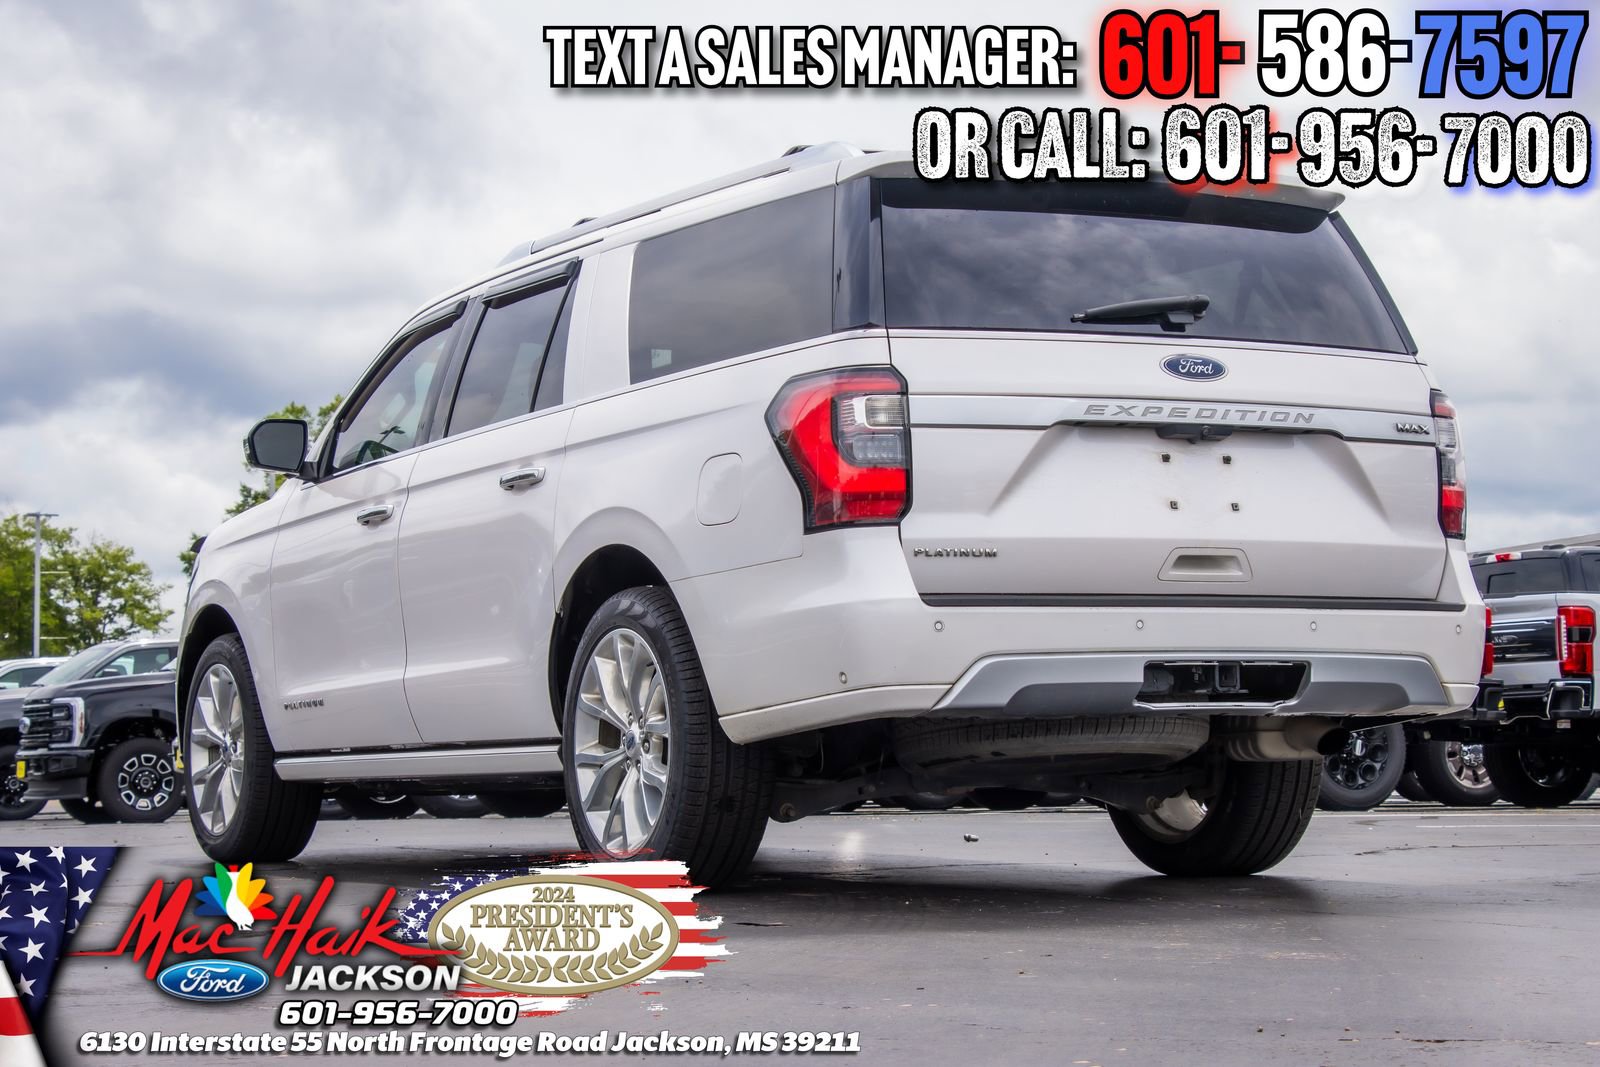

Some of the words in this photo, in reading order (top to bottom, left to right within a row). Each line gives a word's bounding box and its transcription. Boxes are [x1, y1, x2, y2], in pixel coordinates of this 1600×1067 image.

[1178, 359, 1215, 375] Ford
[1083, 404, 1317, 424] EXPEDITION
[1396, 422, 1430, 435] MAX
[914, 547, 998, 558] PLATINUM
